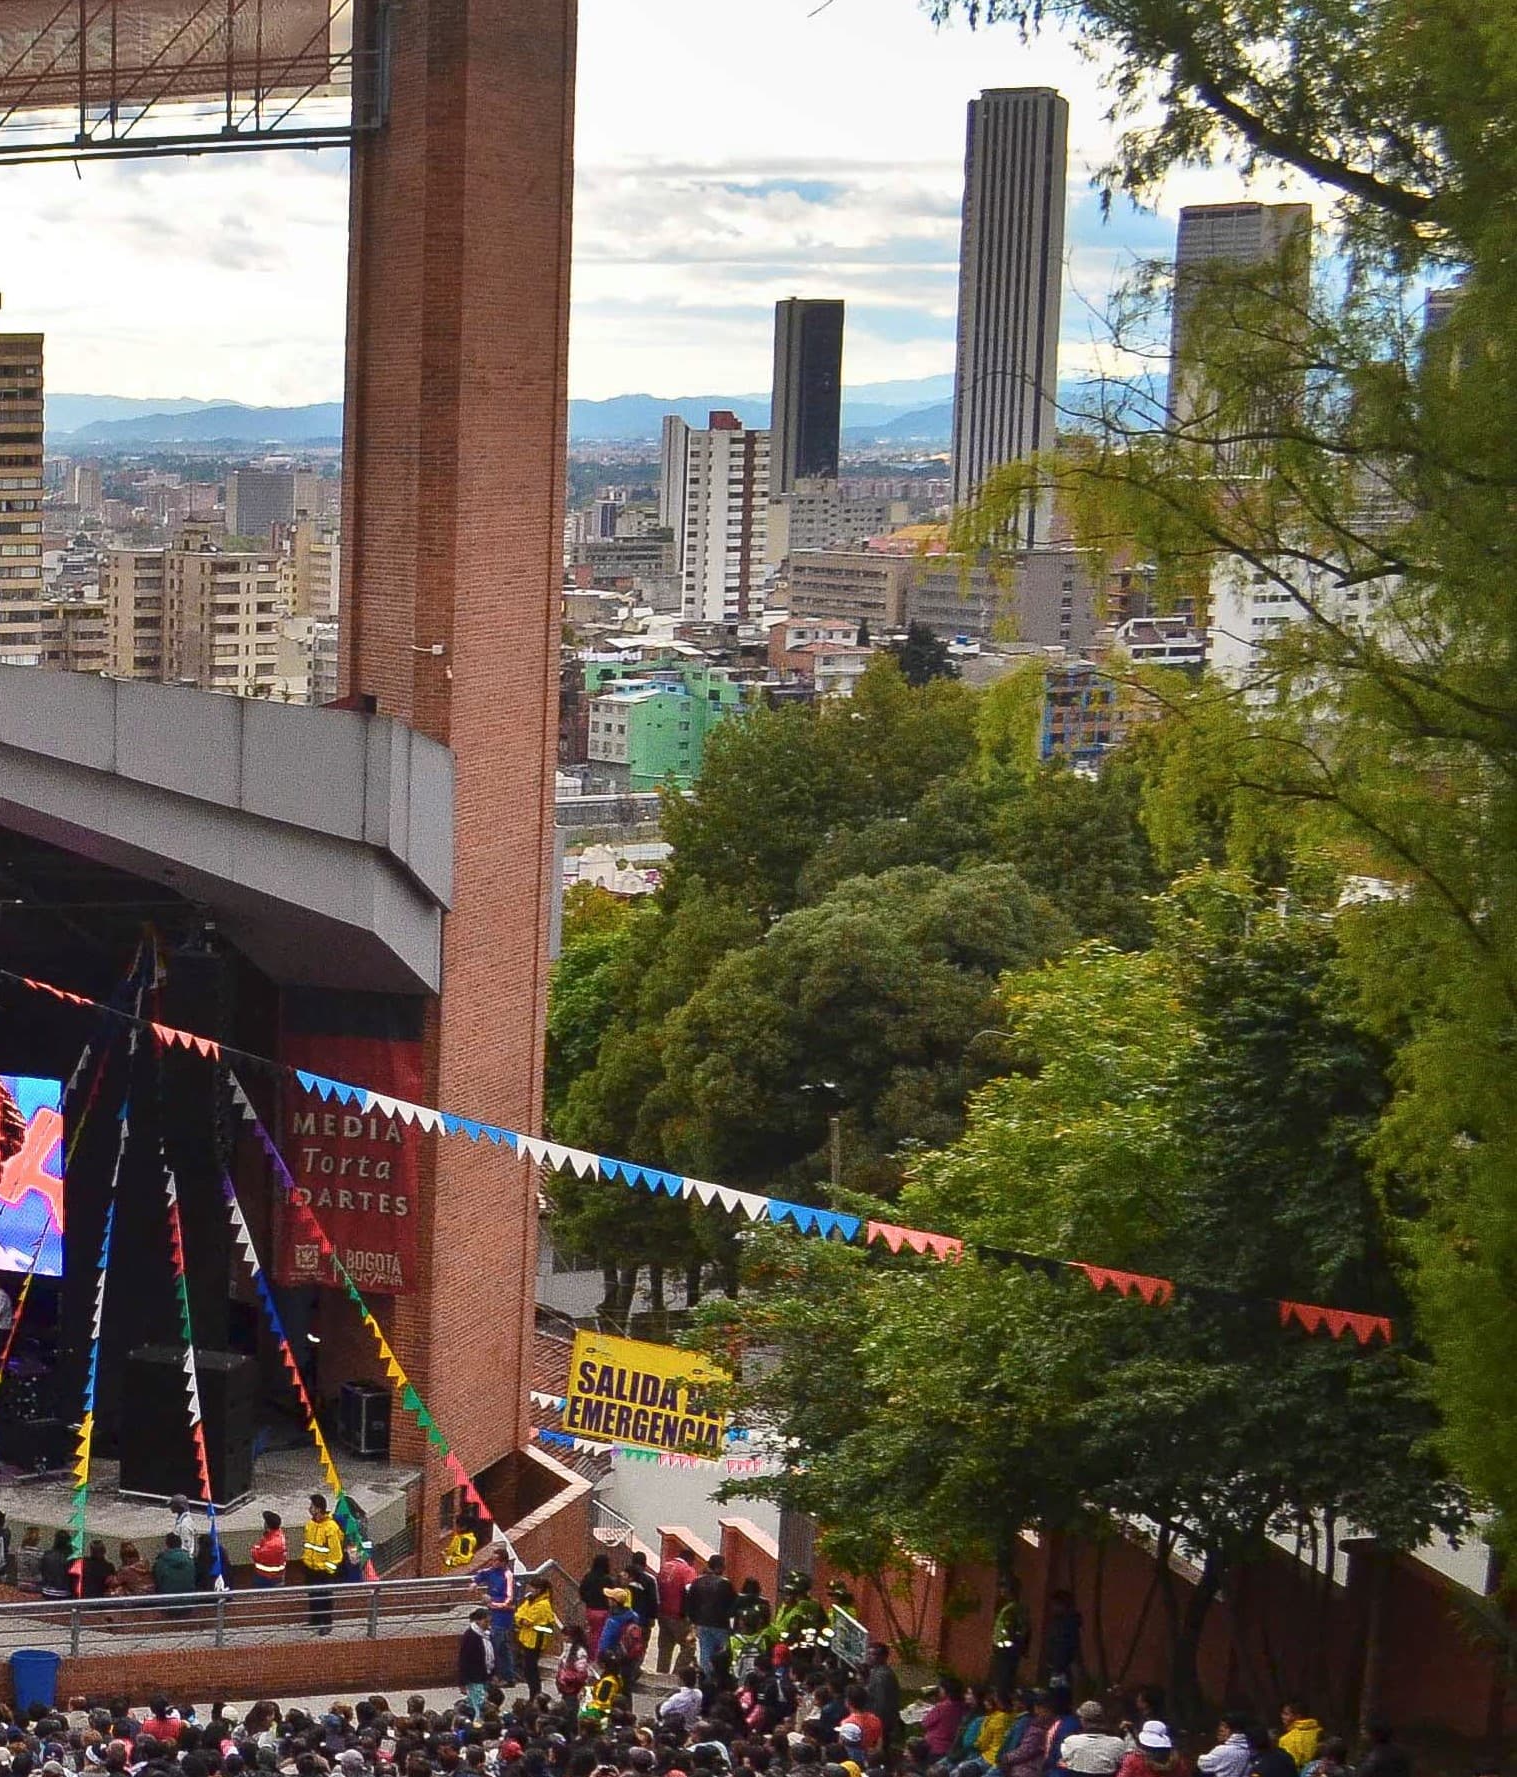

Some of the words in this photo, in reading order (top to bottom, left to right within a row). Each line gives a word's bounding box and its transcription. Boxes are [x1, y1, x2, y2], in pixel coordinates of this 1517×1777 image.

[293, 1112, 402, 1144] MEDIA
[303, 1148, 391, 1180] Torta
[345, 1249, 402, 1275] BOGOTÁ
[577, 1361, 678, 1413] SALIDA
[567, 1395, 719, 1452] EMERGENCIA
